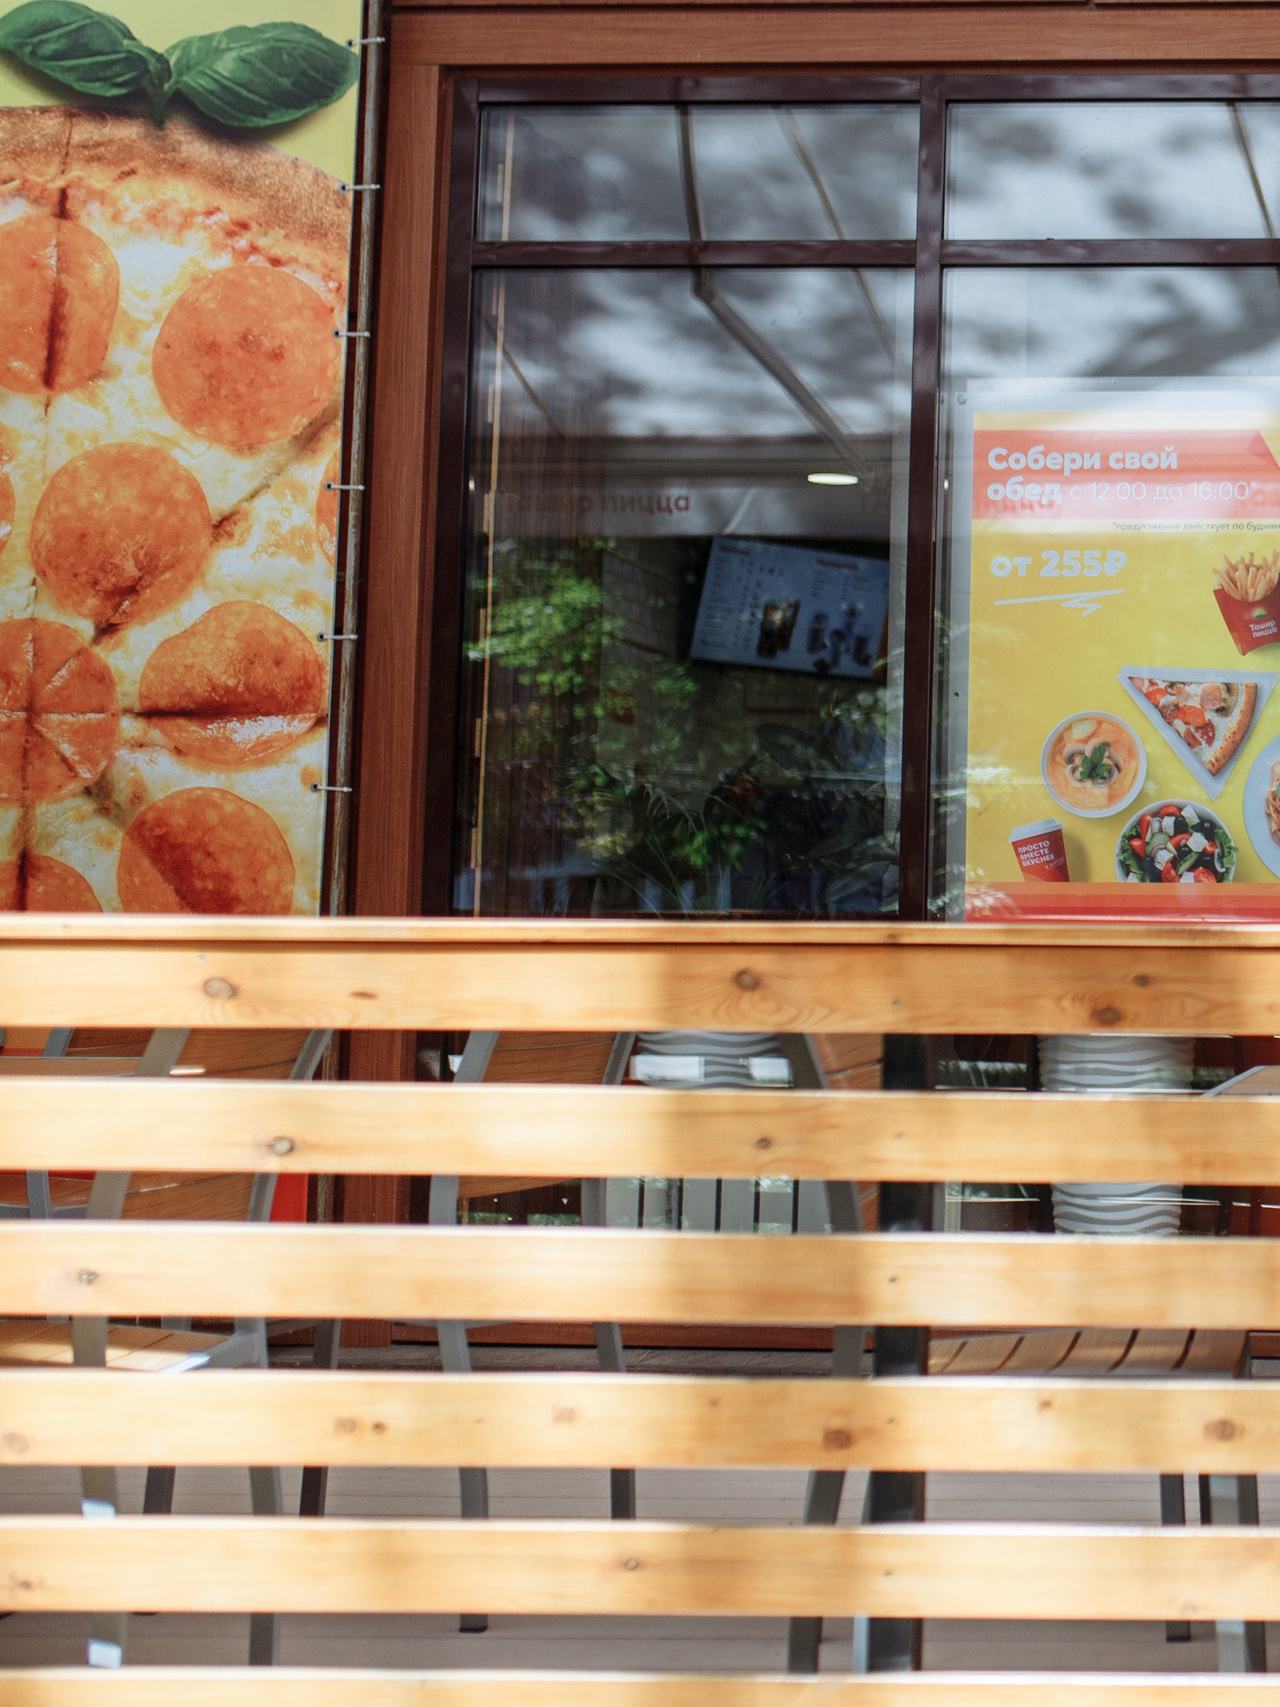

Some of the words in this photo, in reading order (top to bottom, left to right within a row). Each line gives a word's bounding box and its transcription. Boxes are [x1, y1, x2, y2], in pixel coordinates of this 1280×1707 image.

[987, 444, 1101, 476] Собери
[1108, 445, 1178, 470] свой
[987, 475, 1062, 504] обед
[1069, 484, 1082, 500] с
[1089, 481, 1147, 500] 12:00
[1153, 484, 1183, 503] до
[1182, 522, 1230, 532] действует
[1232, 523, 1245, 531] по
[1246, 521, 1280, 532] будням
[990, 555, 1031, 577] от
[1249, 620, 1276, 632] Ташир
[1252, 626, 1278, 638] пицца
[1018, 840, 1050, 853] ПРОСТО
[1020, 848, 1050, 860] ВМЕСТЕ
[1022, 854, 1055, 867] ВКУСНЕЕ
